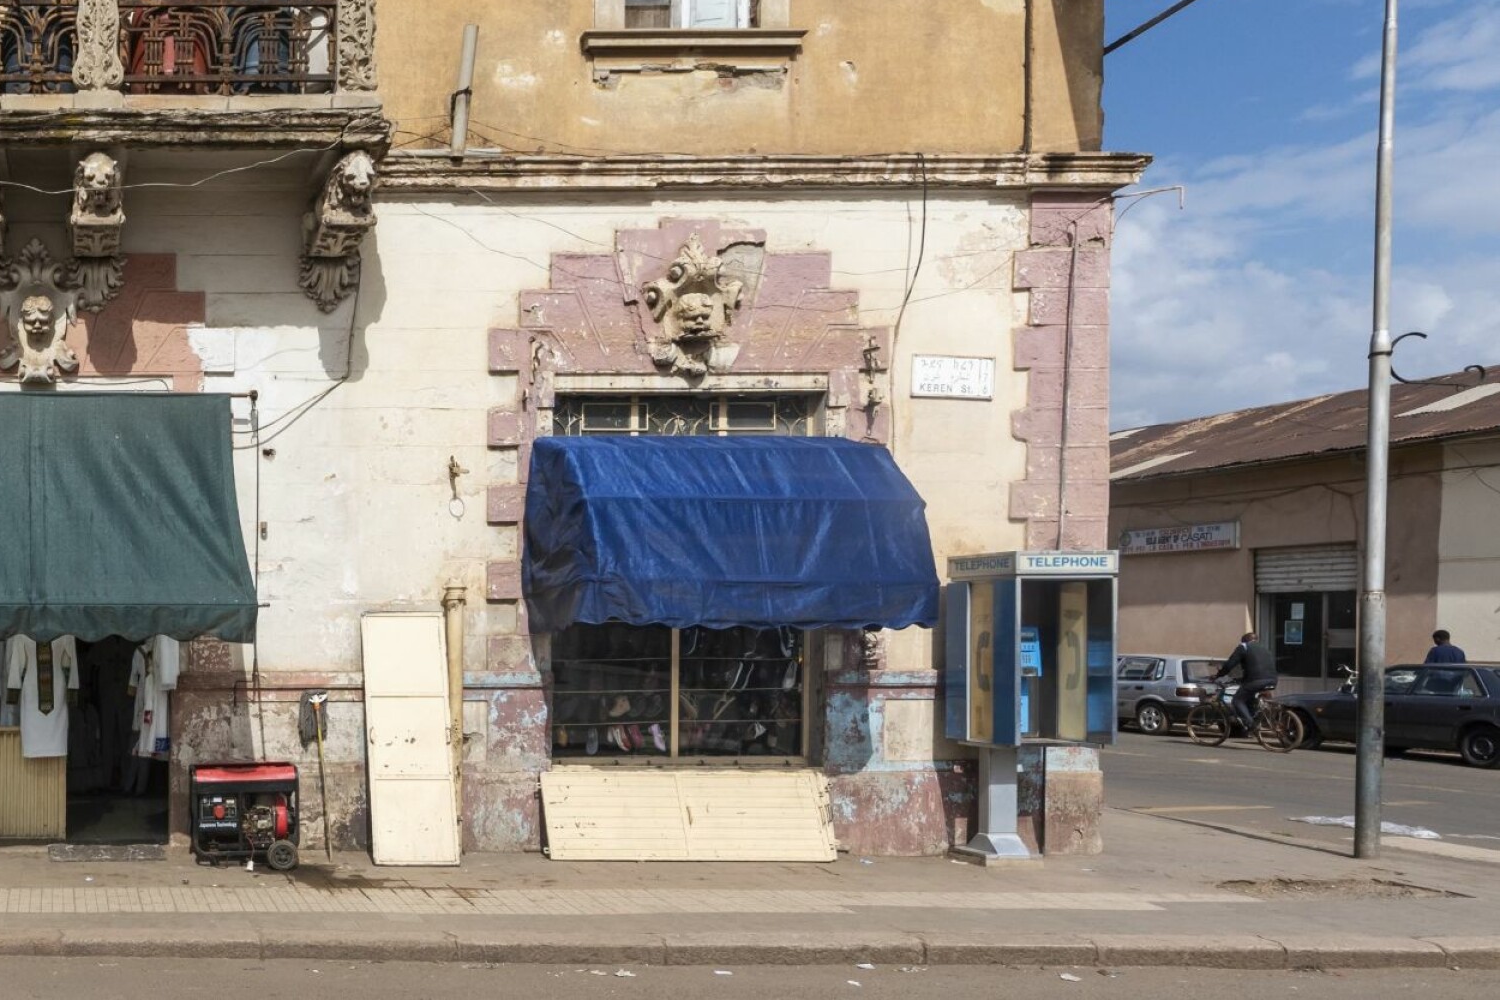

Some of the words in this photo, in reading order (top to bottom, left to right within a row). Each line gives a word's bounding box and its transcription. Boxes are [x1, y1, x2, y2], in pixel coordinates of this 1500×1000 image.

[920, 383, 953, 393] KEREN
[1180, 532, 1213, 542] CASATI
[955, 557, 1010, 570] TELEPHONE
[1028, 556, 1108, 568] TELEPHONE
